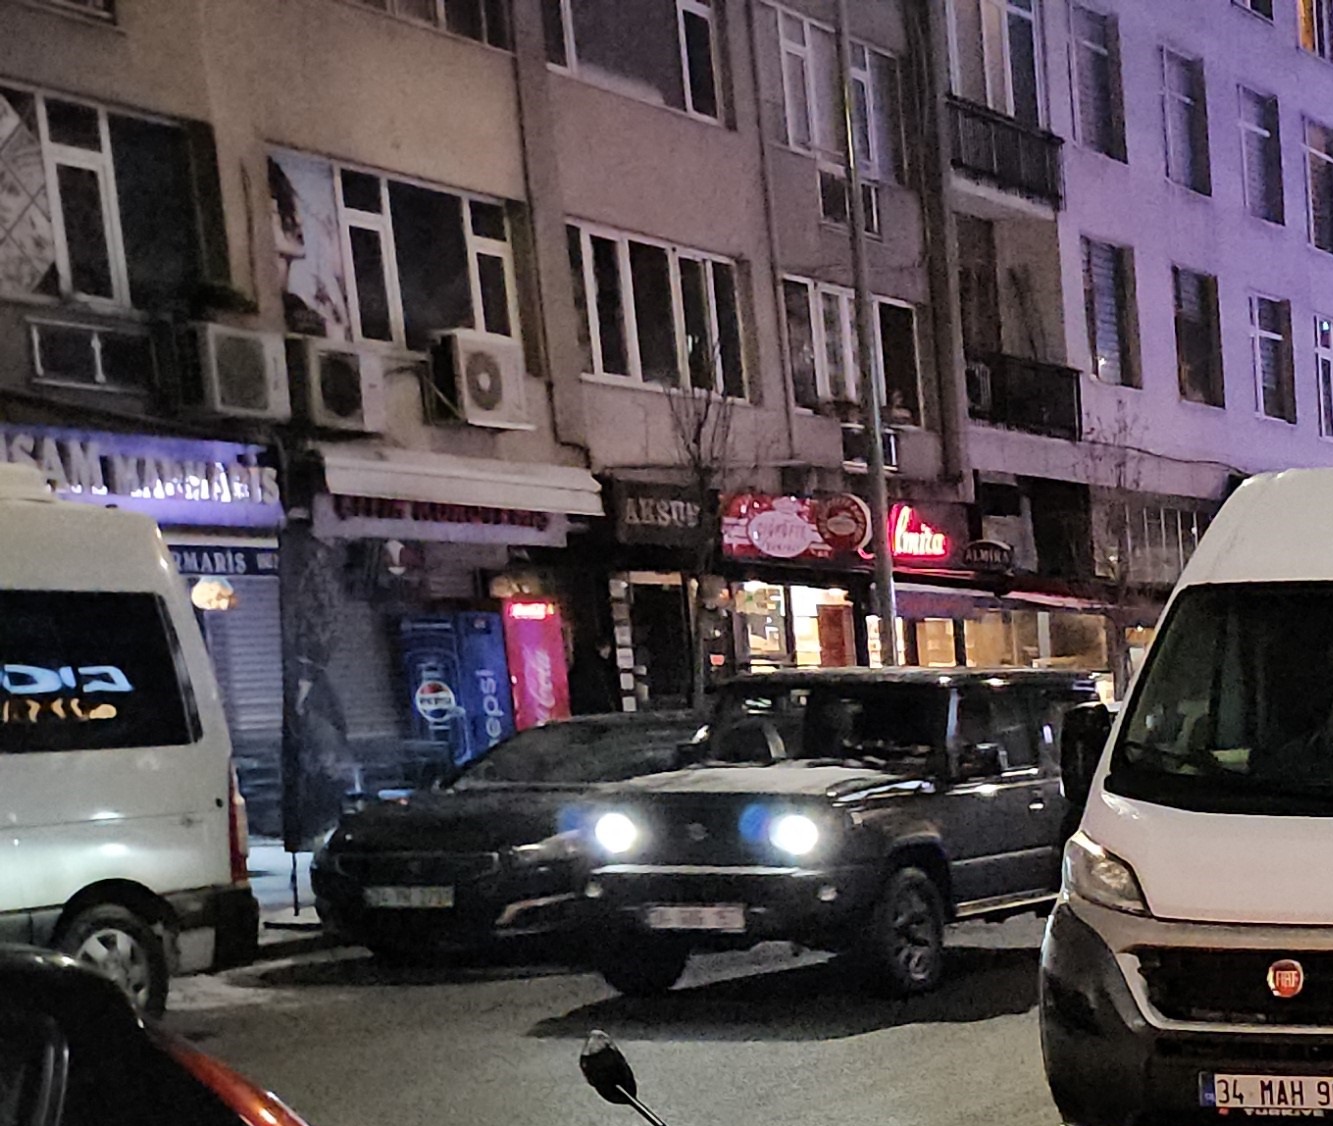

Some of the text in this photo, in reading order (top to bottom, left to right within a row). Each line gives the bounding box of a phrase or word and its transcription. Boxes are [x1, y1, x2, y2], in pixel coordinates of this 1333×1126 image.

[1275, 970, 1299, 988] FIAT
[1217, 1079, 1245, 1104] 34
[1260, 1080, 1304, 1106] MAH
